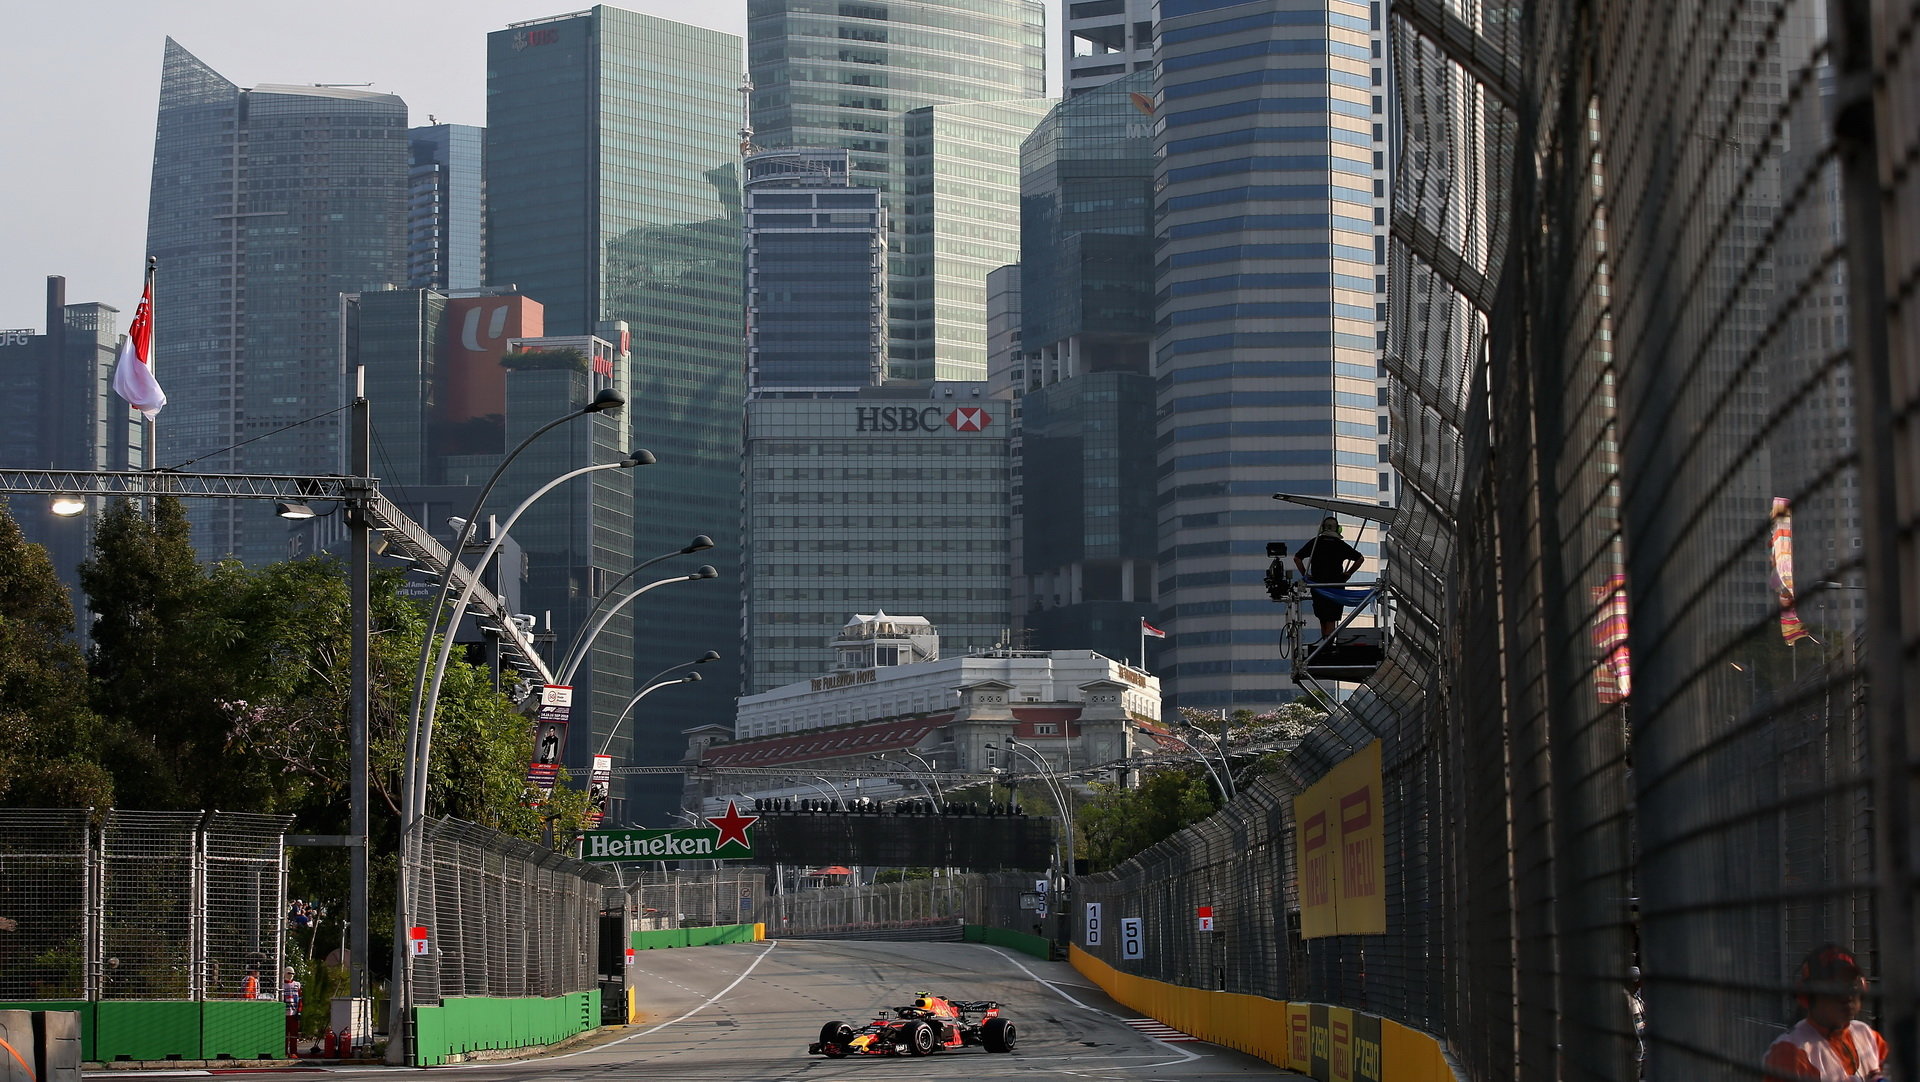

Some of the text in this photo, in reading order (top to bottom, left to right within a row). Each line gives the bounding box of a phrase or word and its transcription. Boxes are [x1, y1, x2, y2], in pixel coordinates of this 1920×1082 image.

[855, 406, 942, 433] HSBC
[411, 588, 429, 597] Lynch
[810, 669, 877, 692] THE FULLERTON HOTEL
[590, 834, 713, 857] Heineken
[1304, 784, 1376, 908] PIRELLI PIRELLI
[1089, 906, 1098, 942] 100
[1203, 919, 1209, 929] F
[417, 941, 424, 953] F
[1125, 922, 1138, 955] 50
[1333, 1020, 1349, 1080] PIRELLI
[1360, 1039, 1379, 1082] ZERO
